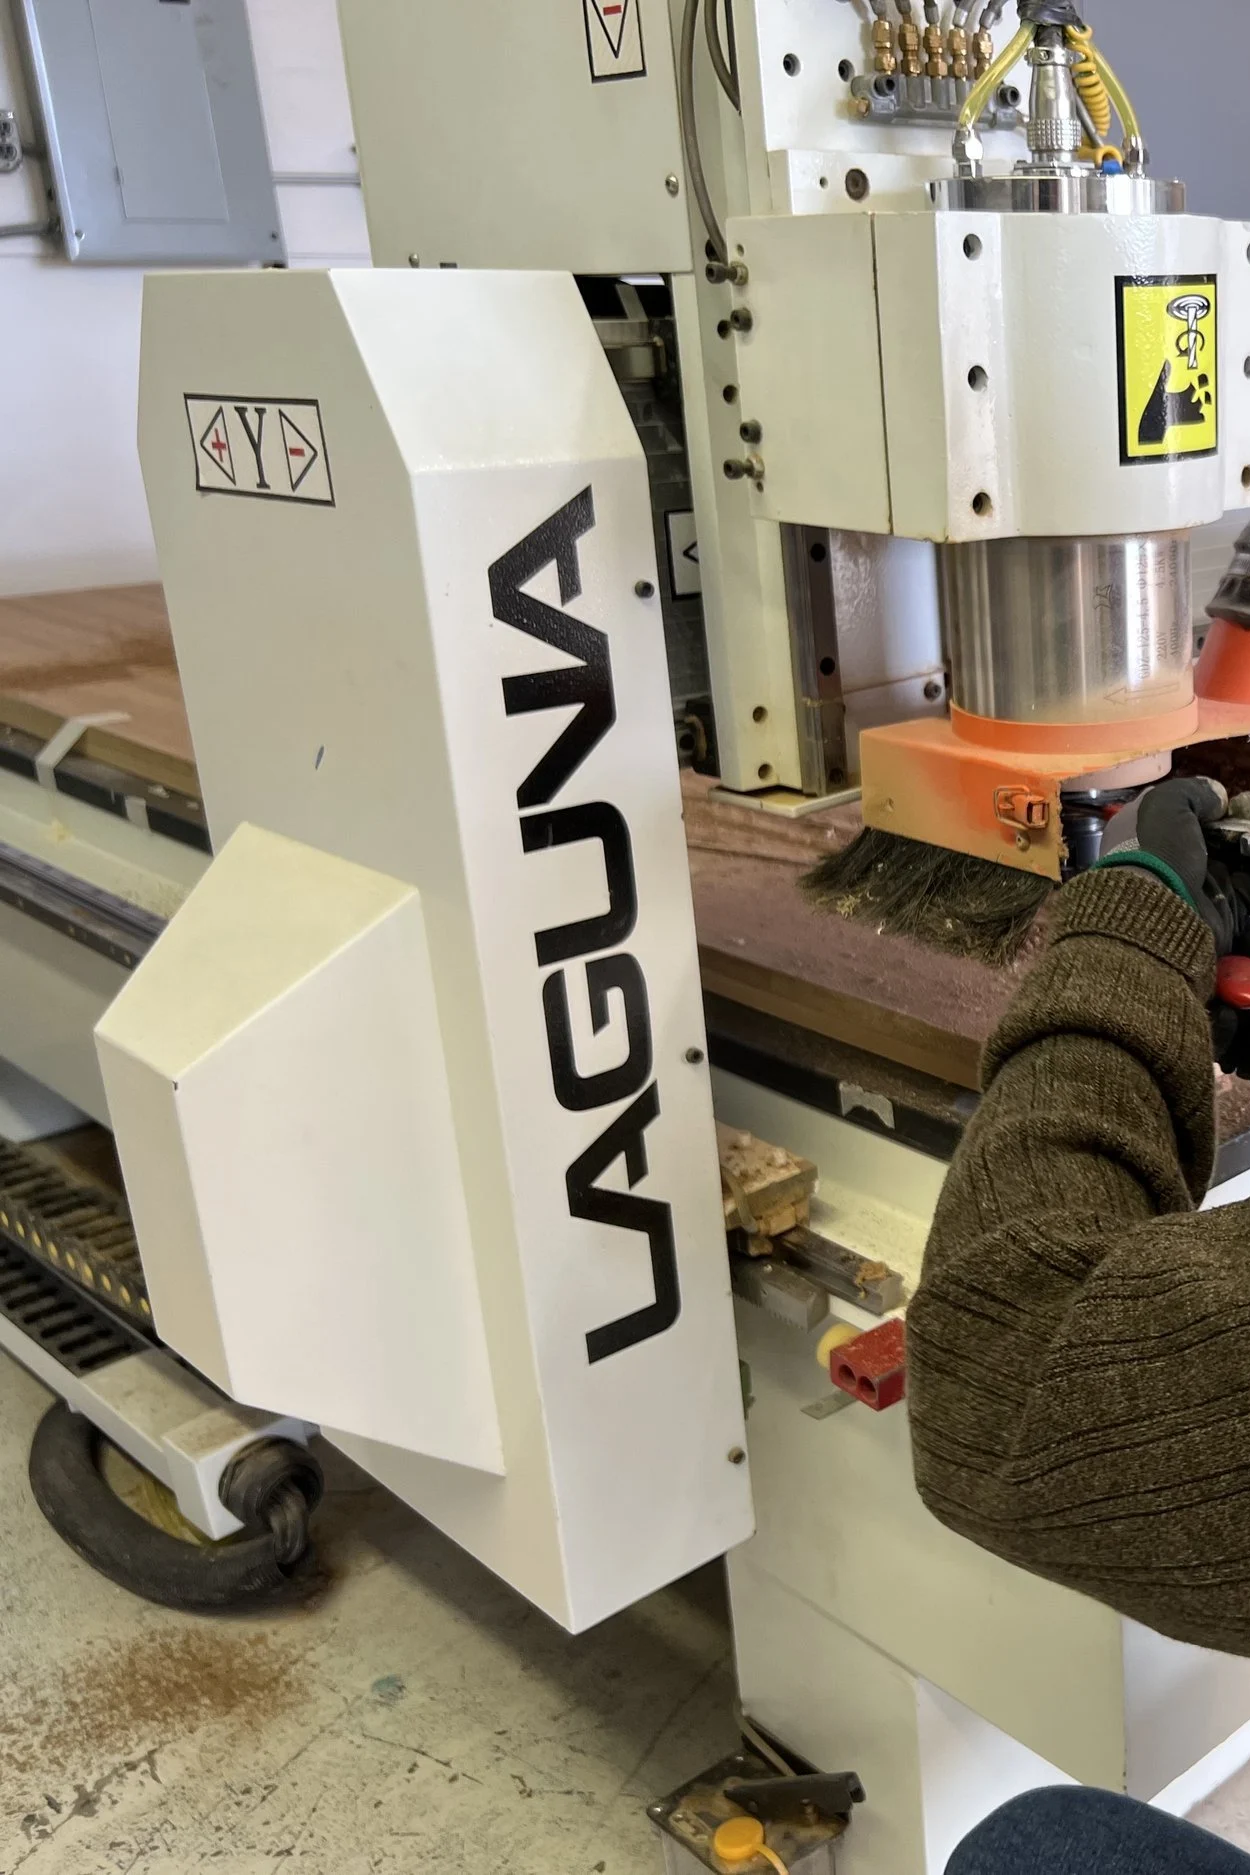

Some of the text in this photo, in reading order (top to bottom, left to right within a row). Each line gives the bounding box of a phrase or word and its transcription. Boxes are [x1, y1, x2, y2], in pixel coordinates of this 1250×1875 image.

[234, 406, 271, 490] Y
[1156, 631, 1168, 661] 220V
[487, 484, 682, 1366] LAGUNA
